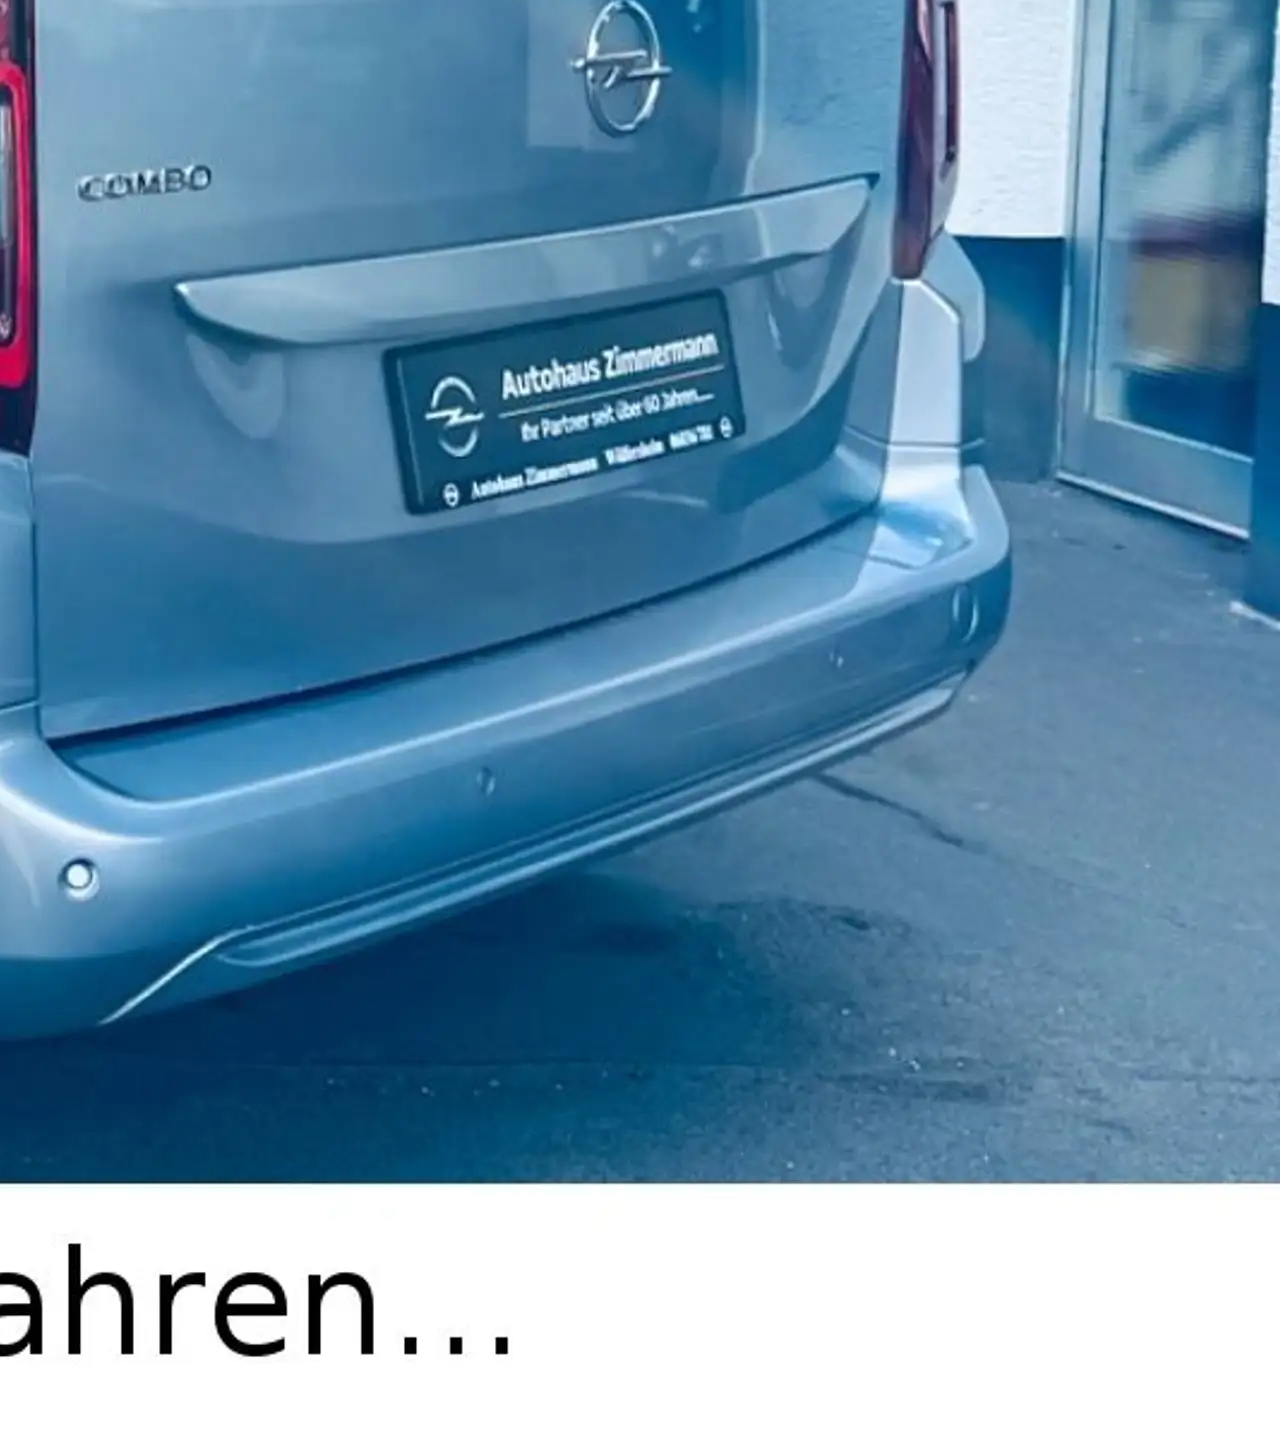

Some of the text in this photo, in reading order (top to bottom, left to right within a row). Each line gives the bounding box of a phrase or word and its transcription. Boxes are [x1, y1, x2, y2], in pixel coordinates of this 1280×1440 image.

[77, 164, 212, 201] COMBO
[502, 333, 719, 400] Autohaus Zimmermann
[541, 414, 590, 438] Partner
[591, 404, 614, 428] seit
[643, 394, 660, 414] 60
